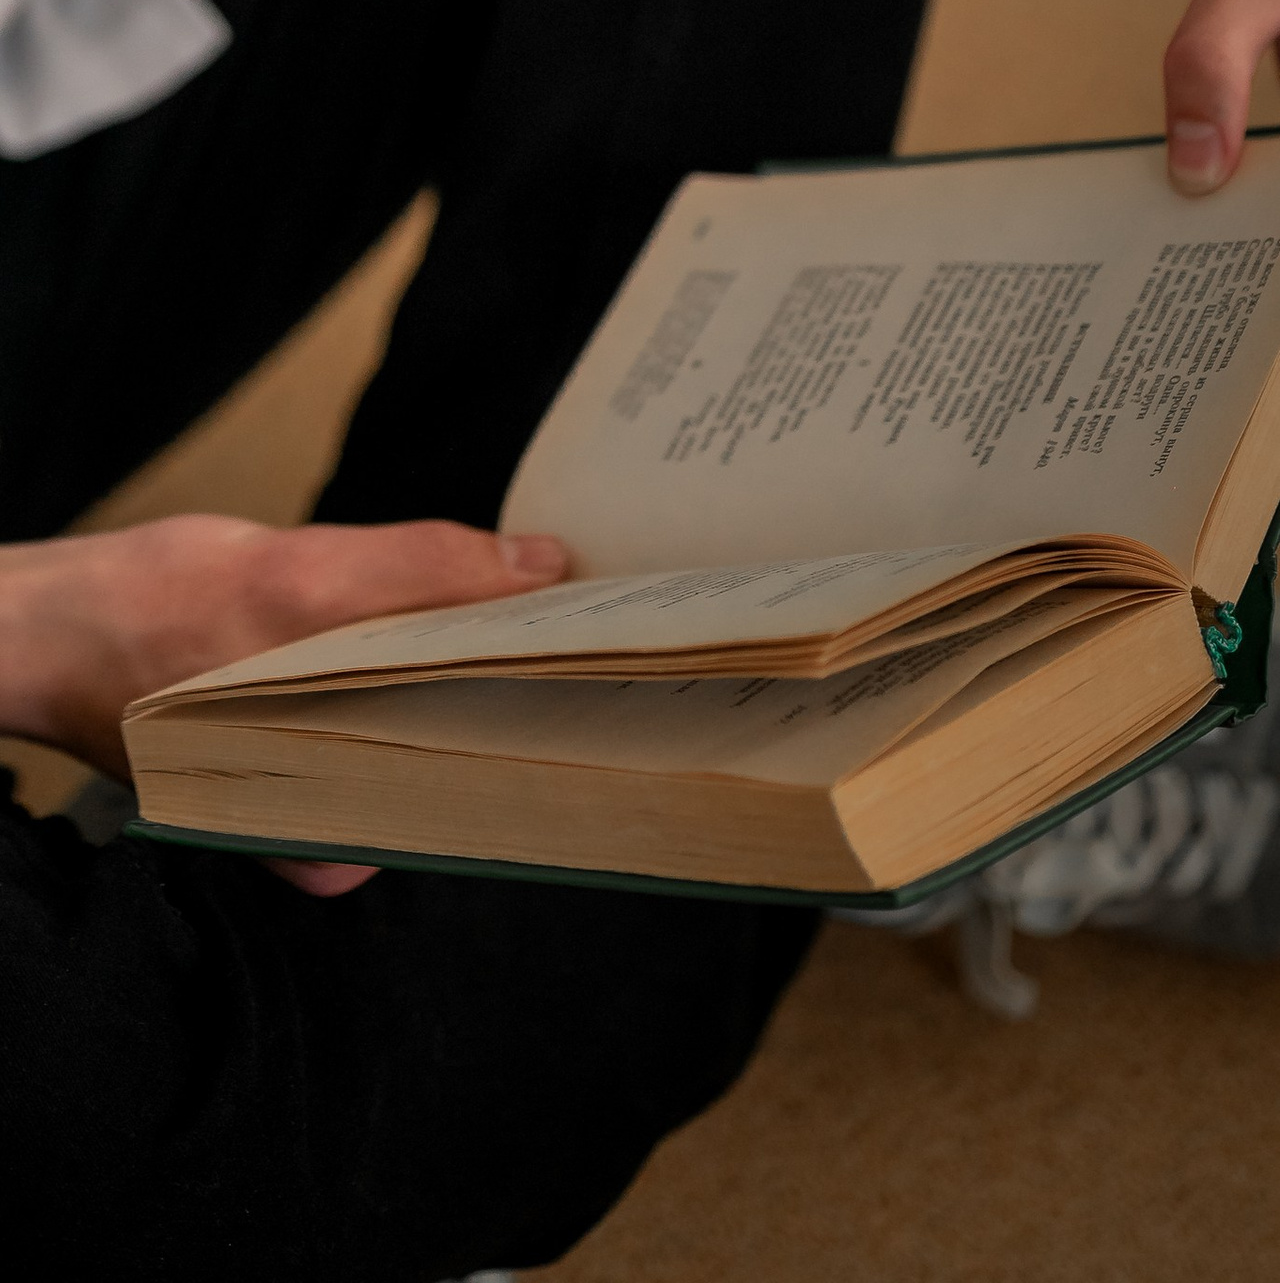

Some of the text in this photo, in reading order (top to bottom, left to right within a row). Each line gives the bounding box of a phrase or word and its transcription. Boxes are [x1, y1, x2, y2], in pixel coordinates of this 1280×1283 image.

[1255, 262, 1275, 289] всех
[1210, 286, 1237, 321] грубо
[1244, 291, 1262, 315] уже
[1202, 336, 1227, 373] жизнь
[1215, 316, 1250, 373] отделена,
[1111, 347, 1148, 410] сибирской
[1129, 377, 1149, 404] лет?
[1135, 373, 1166, 421] подруги
[1152, 374, 1182, 416] Одна...
[1077, 413, 1103, 452] круге?
[1149, 380, 1191, 447] опрокинут,
[1171, 393, 1198, 434] сердца
[1089, 414, 1117, 454] вьюге?
[1148, 437, 1177, 478] вынут,
